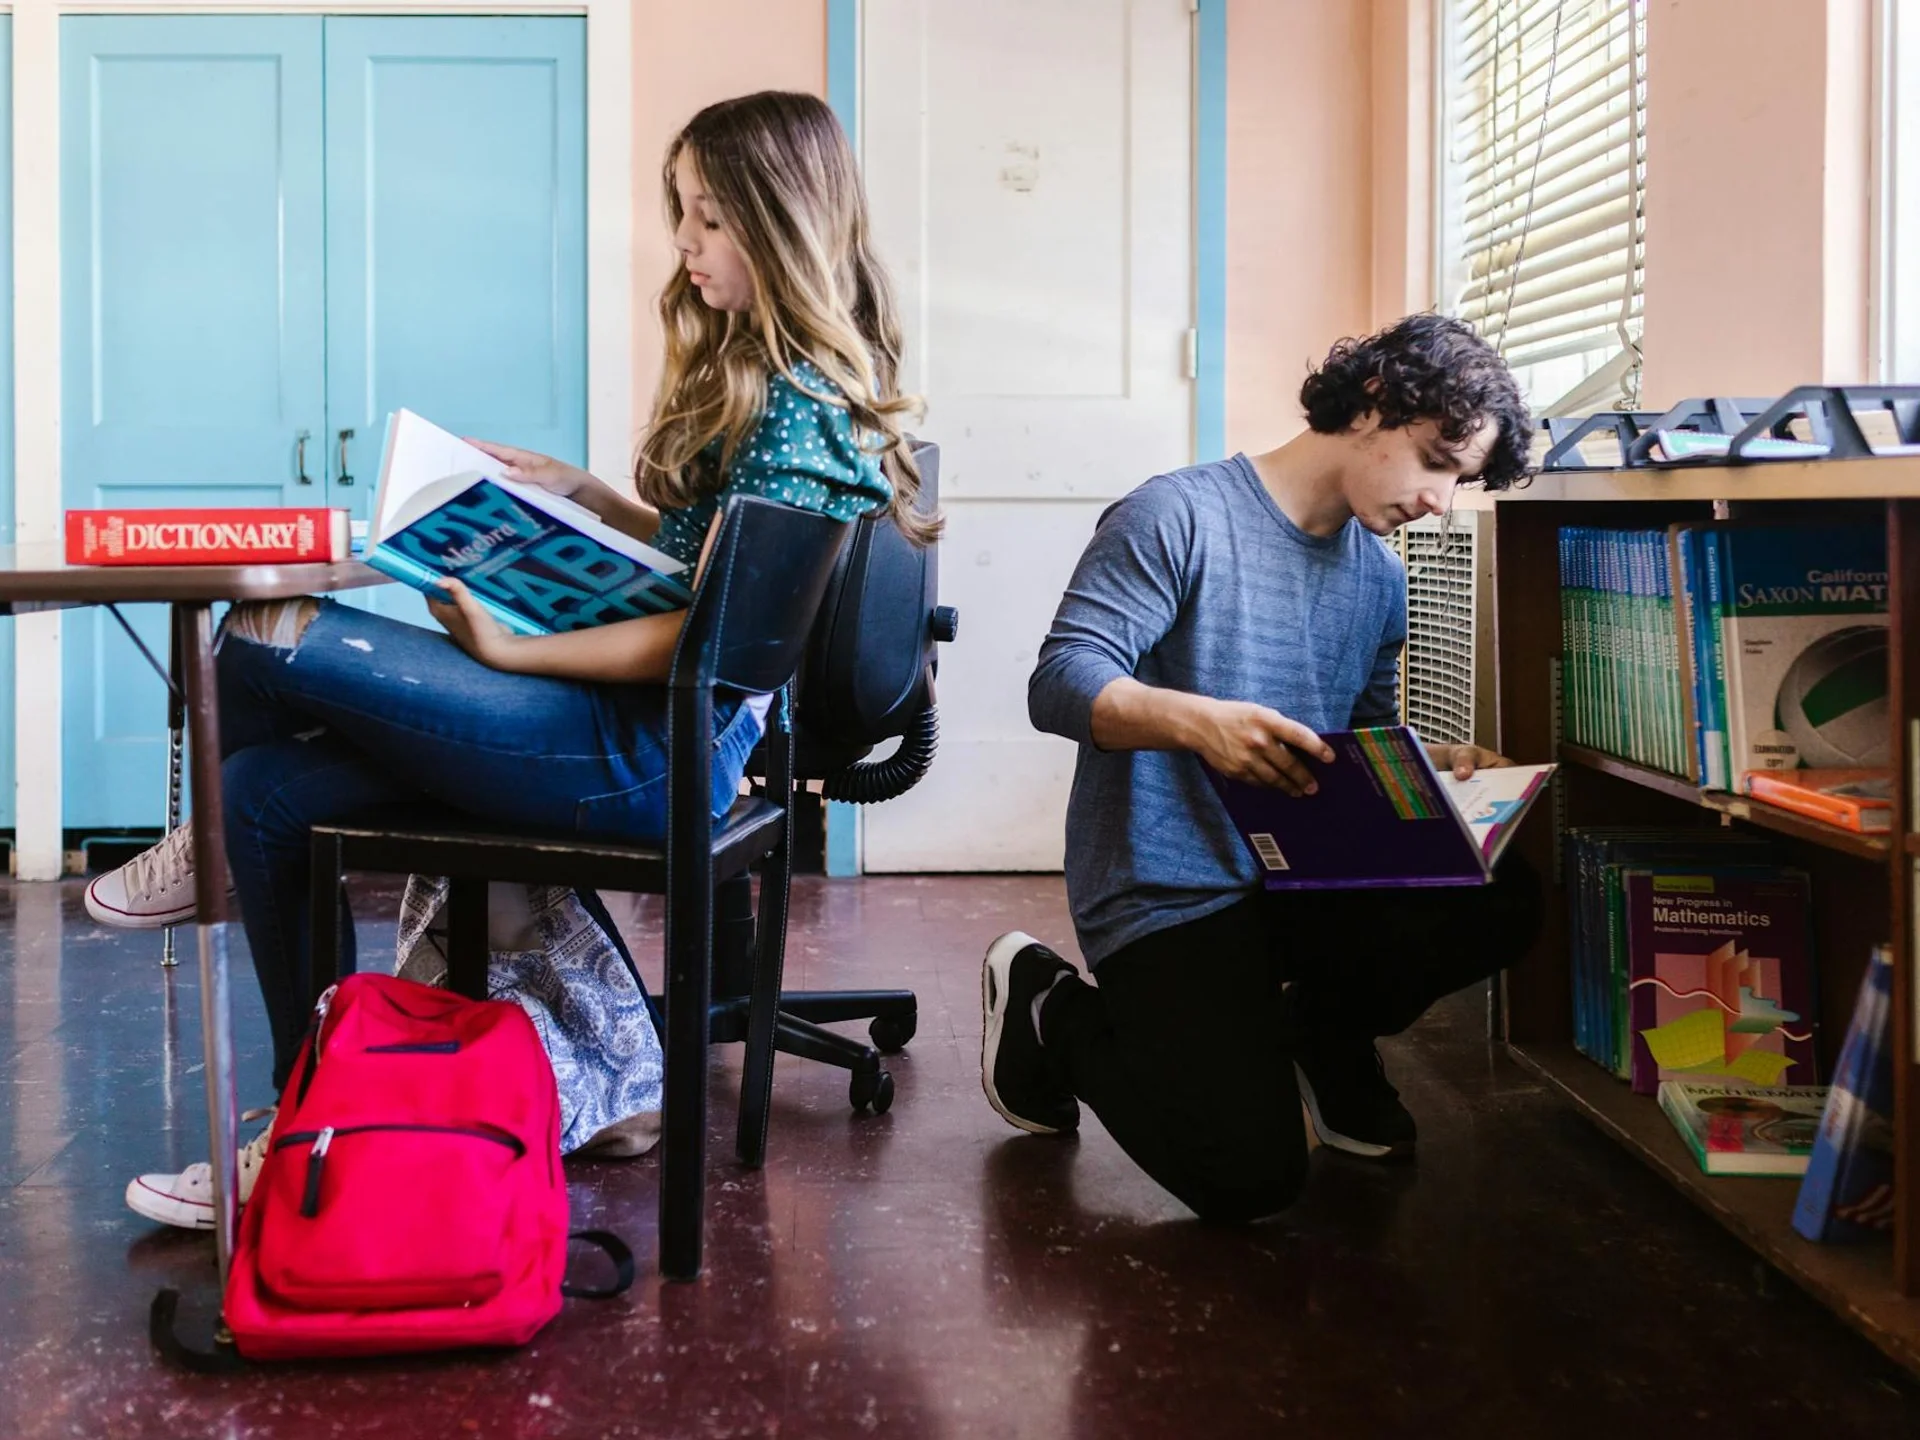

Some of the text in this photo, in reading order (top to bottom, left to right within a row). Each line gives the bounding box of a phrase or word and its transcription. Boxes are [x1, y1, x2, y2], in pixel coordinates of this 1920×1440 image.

[126, 523, 297, 550] DICTIONARY
[441, 523, 517, 571] Algebra
[1708, 546, 1717, 601] California
[1807, 569, 1888, 584] Californ
[1821, 585, 1887, 603] MAT
[1653, 896, 1732, 909] New Progress in
[1653, 907, 1771, 927] Mathematics
